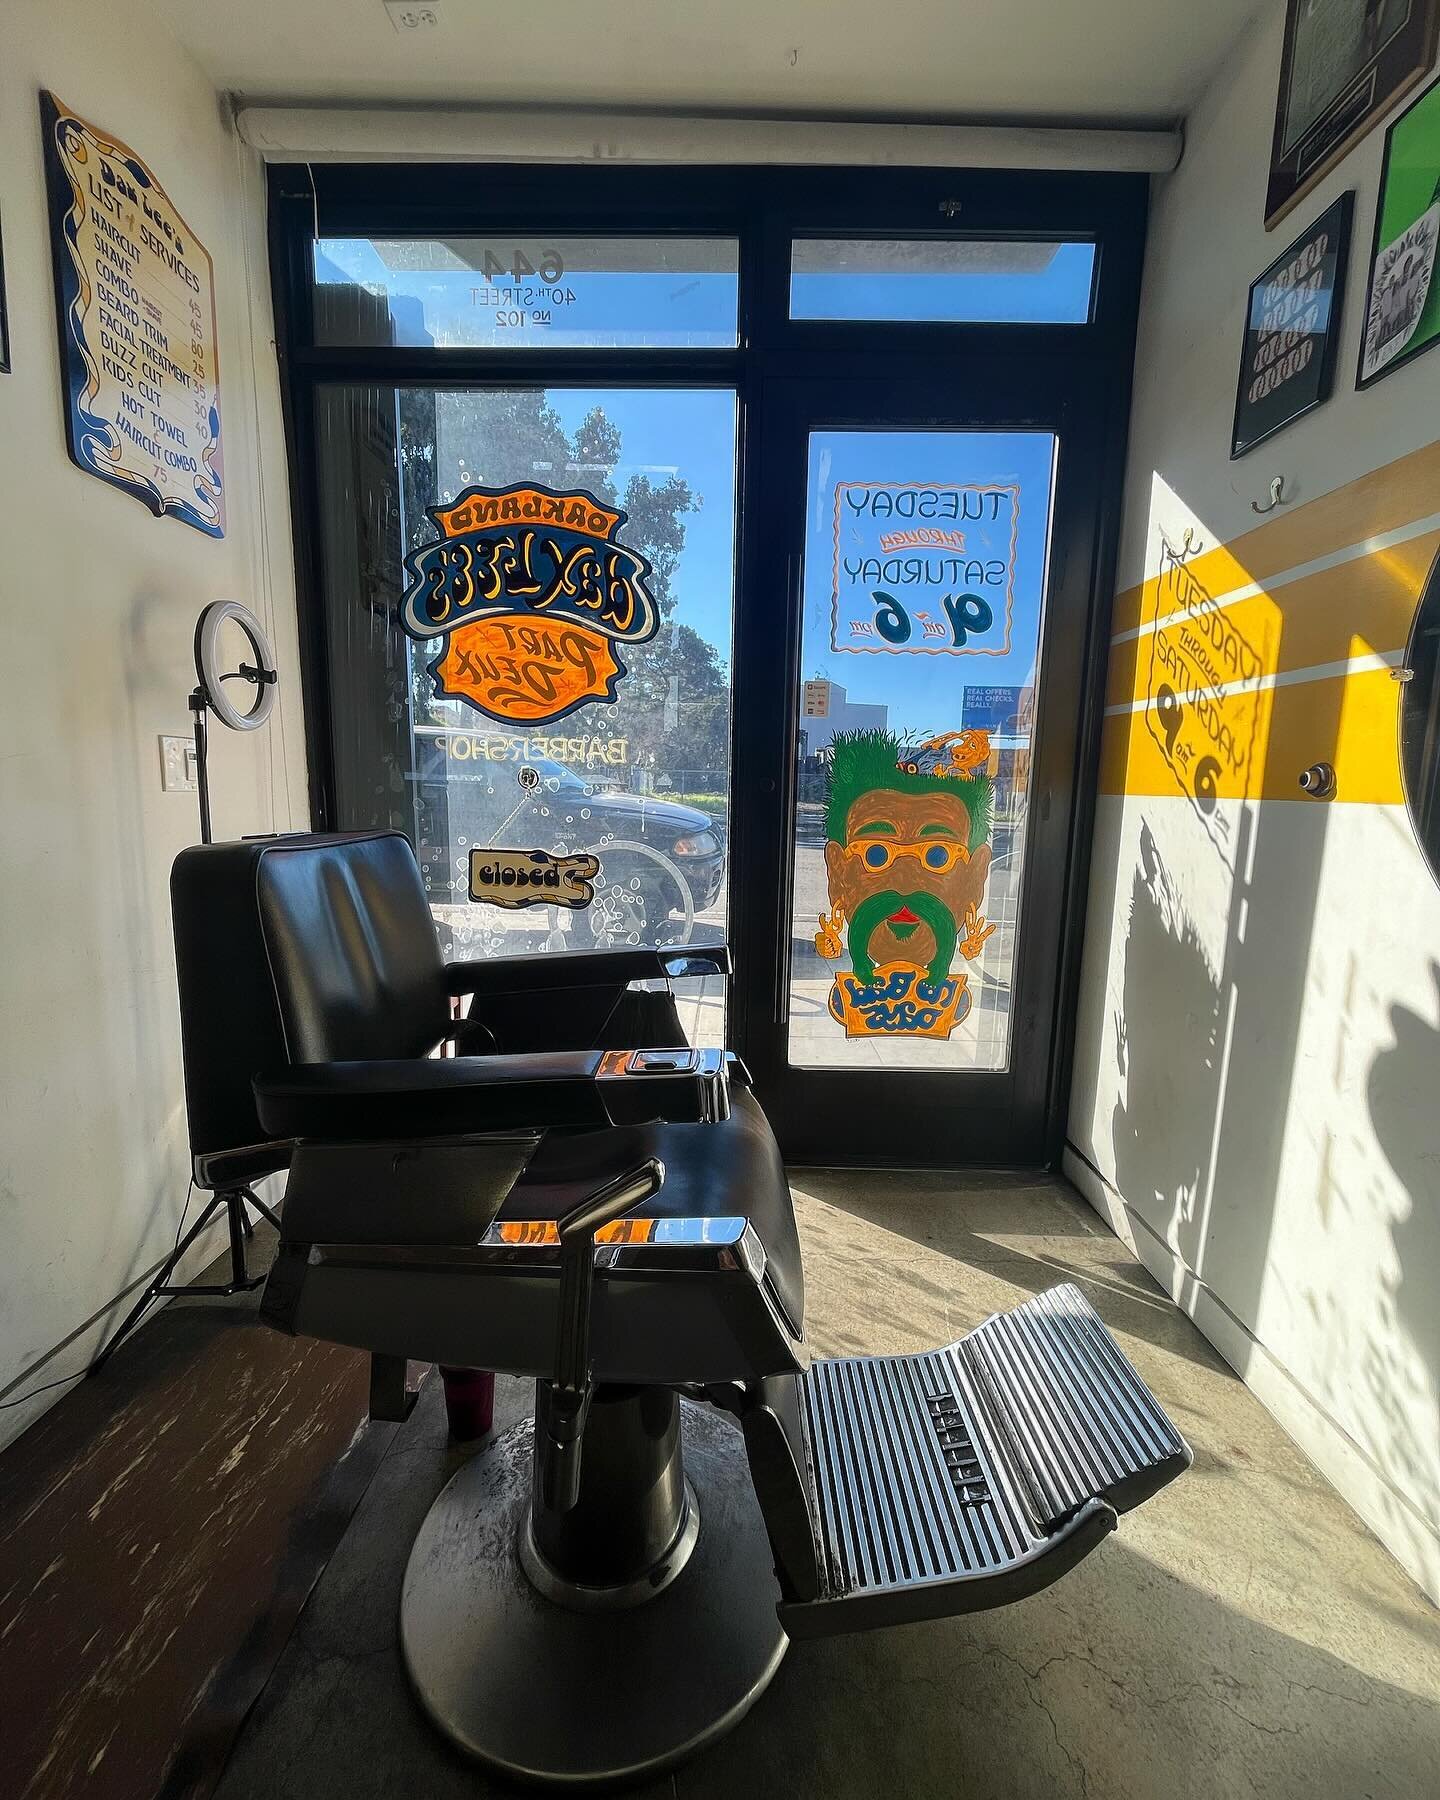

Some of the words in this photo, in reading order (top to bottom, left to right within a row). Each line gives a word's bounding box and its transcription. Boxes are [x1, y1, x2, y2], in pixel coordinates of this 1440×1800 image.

[88, 172, 122, 220] LIST
[139, 223, 200, 294] SERVICES
[91, 210, 142, 265] HAIRCUT
[188, 297, 202, 319] 45
[94, 233, 133, 280] SHAVE
[190, 318, 203, 341] 45
[96, 259, 139, 306] COMBO
[190, 337, 204, 360] 80
[97, 282, 140, 327] BEARD
[142, 318, 169, 352] TRIM
[192, 360, 205, 379] 25
[99, 306, 139, 350] FACIAL
[139, 338, 191, 389] TREATMENT
[193, 379, 207, 400] 35
[100, 330, 137, 370] BUZZ
[142, 364, 164, 389] CUT
[193, 399, 207, 420] 30
[102, 354, 134, 389] KIDS
[138, 382, 161, 408] CUT
[194, 421, 208, 440] 40
[115, 411, 162, 462] HAIRCUT
[164, 448, 198, 474] COMBO
[121, 391, 145, 420] HOT
[151, 411, 189, 449] TOWEL
[153, 464, 168, 484] 75
[1165, 554, 1255, 690] TUESDAY
[1179, 626, 1227, 700] THROUGH
[967, 688, 985, 696] REAL
[1157, 629, 1245, 777] SATURDAY
[1194, 755, 1222, 816] 6
[479, 862, 561, 888] closed
